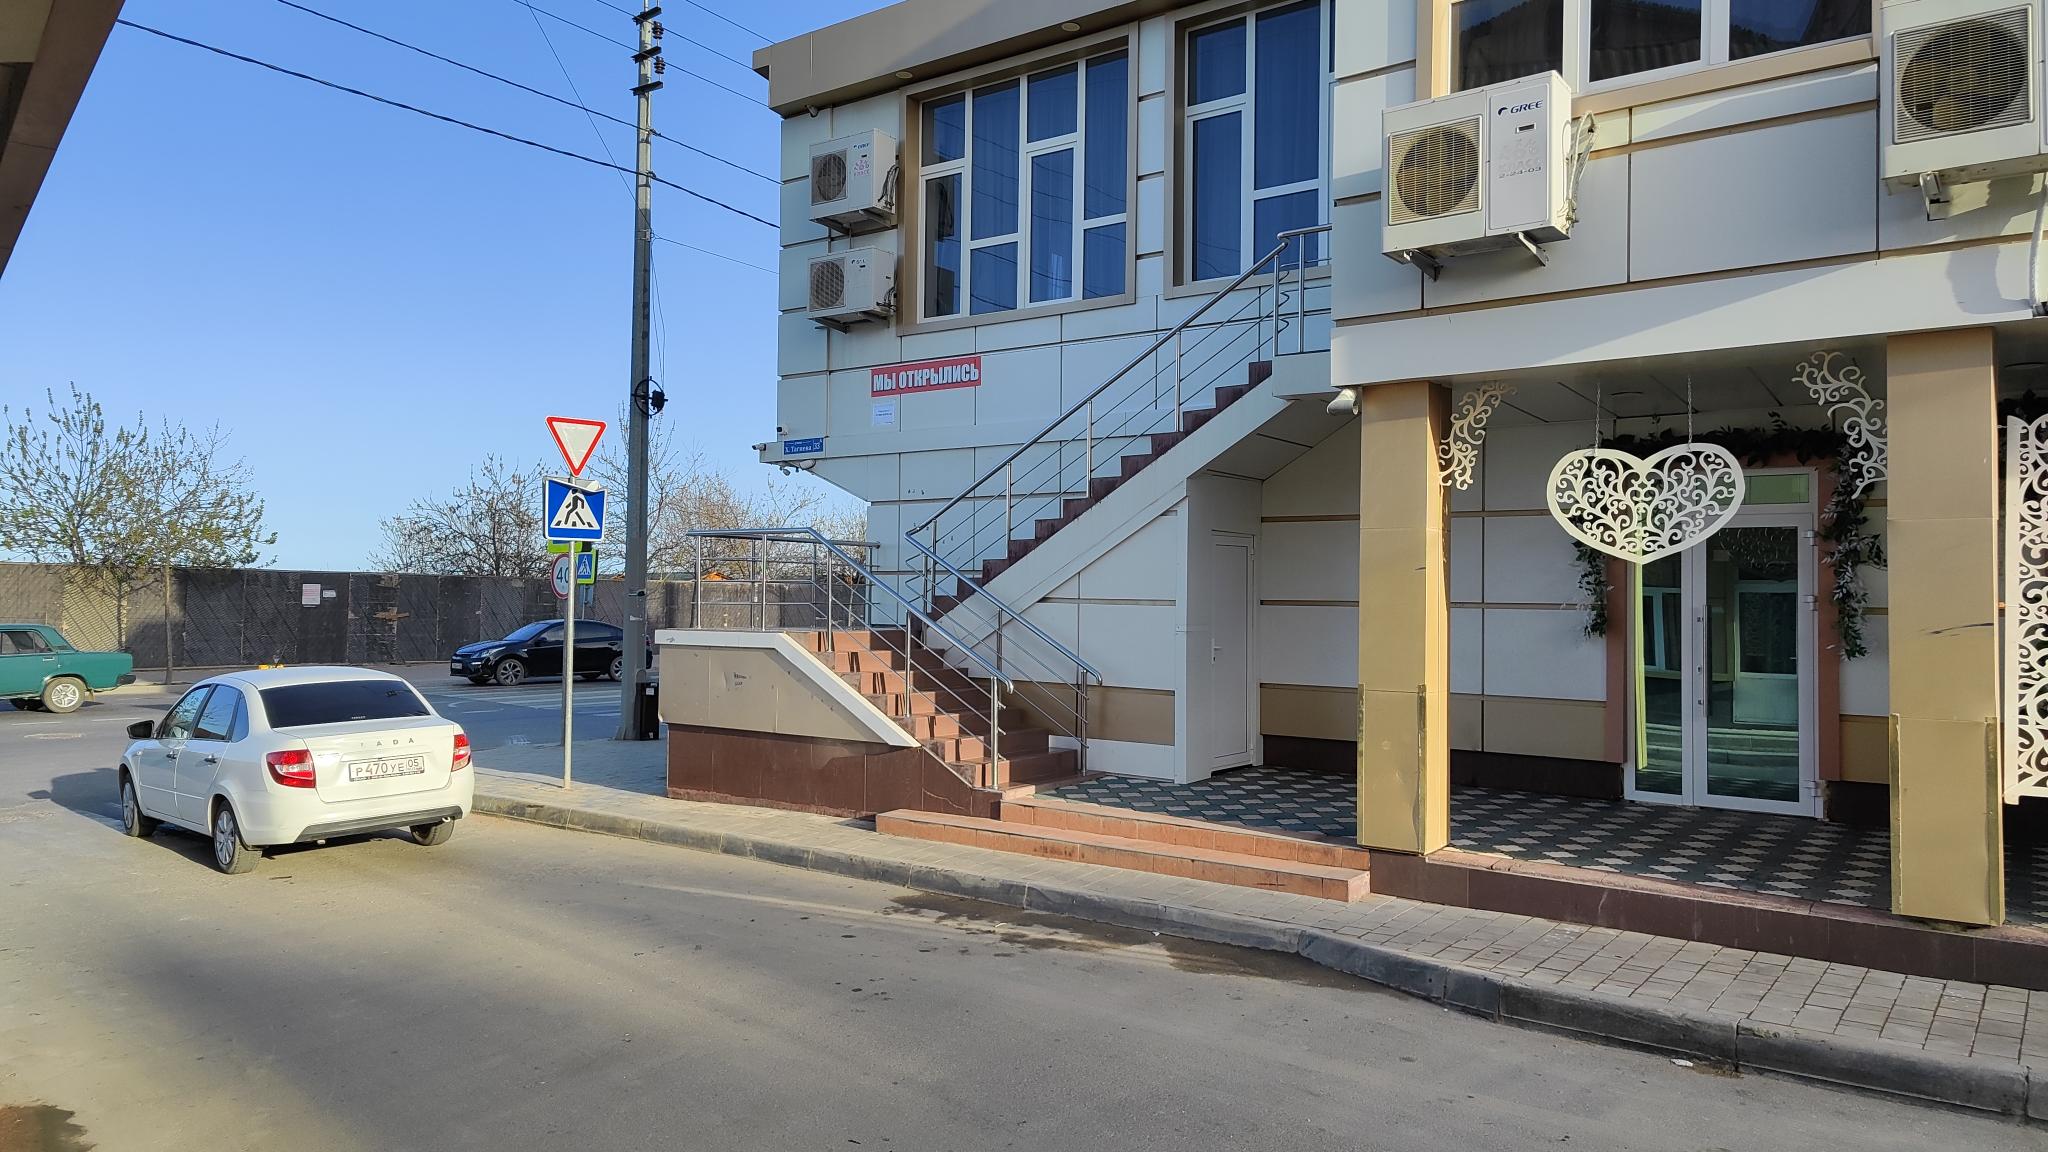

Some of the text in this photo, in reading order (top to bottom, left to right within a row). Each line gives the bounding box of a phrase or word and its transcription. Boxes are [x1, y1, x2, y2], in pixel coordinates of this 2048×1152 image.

[1510, 100, 1543, 114] GREE
[873, 364, 979, 391] МЫ ОТКРЫЛИСЬ
